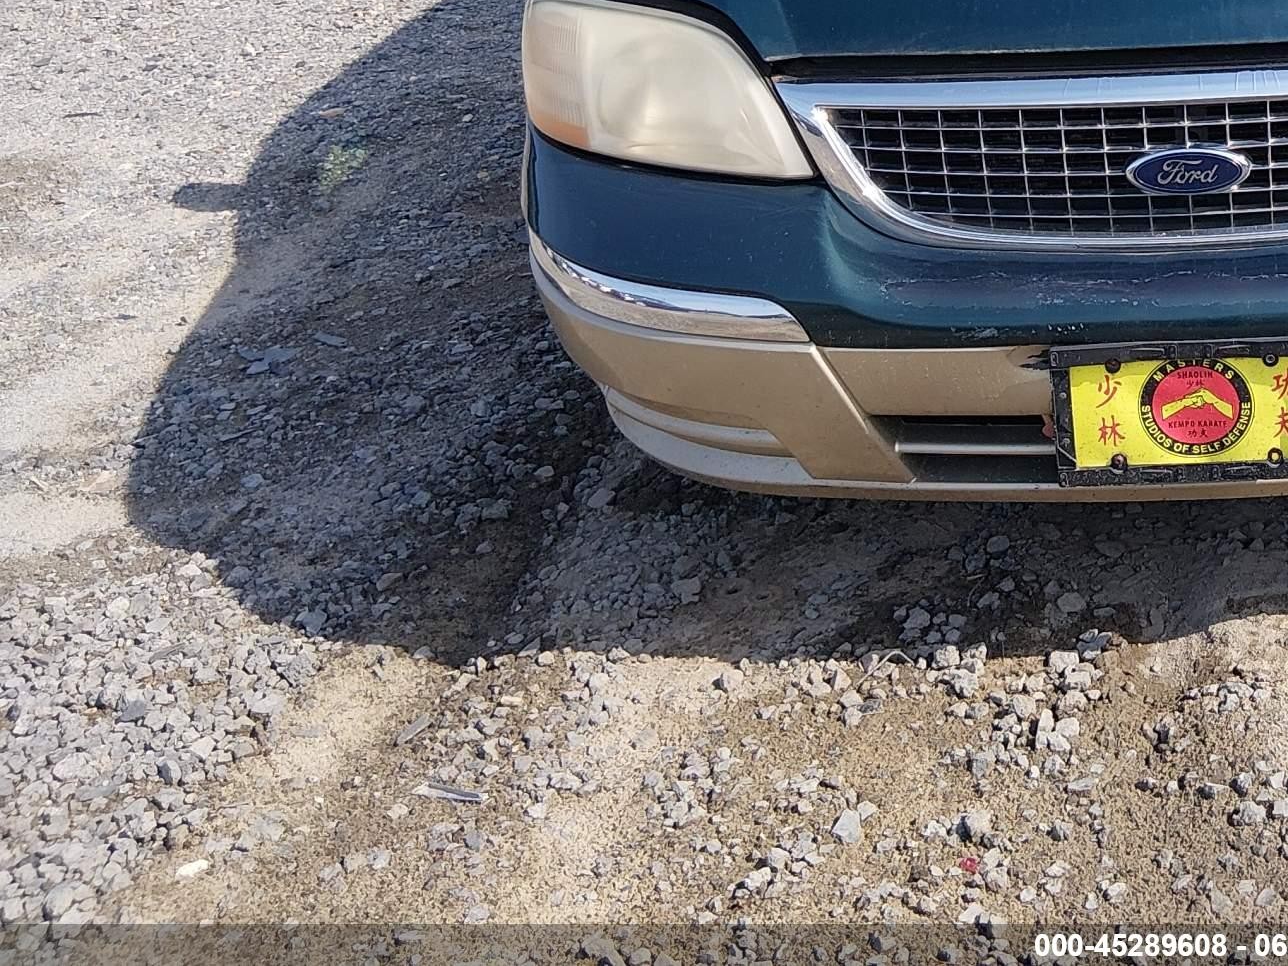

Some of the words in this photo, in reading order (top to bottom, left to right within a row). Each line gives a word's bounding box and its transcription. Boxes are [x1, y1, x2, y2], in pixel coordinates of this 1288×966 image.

[1157, 159, 1218, 184] Ford
[1177, 371, 1213, 379] SHAOLIN
[1096, 375, 1125, 447] 少林
[1142, 405, 1172, 448] STUDIOS
[1173, 443, 1190, 453] OF
[1192, 441, 1222, 453] SELF
[1222, 401, 1251, 445] DEFENSE
